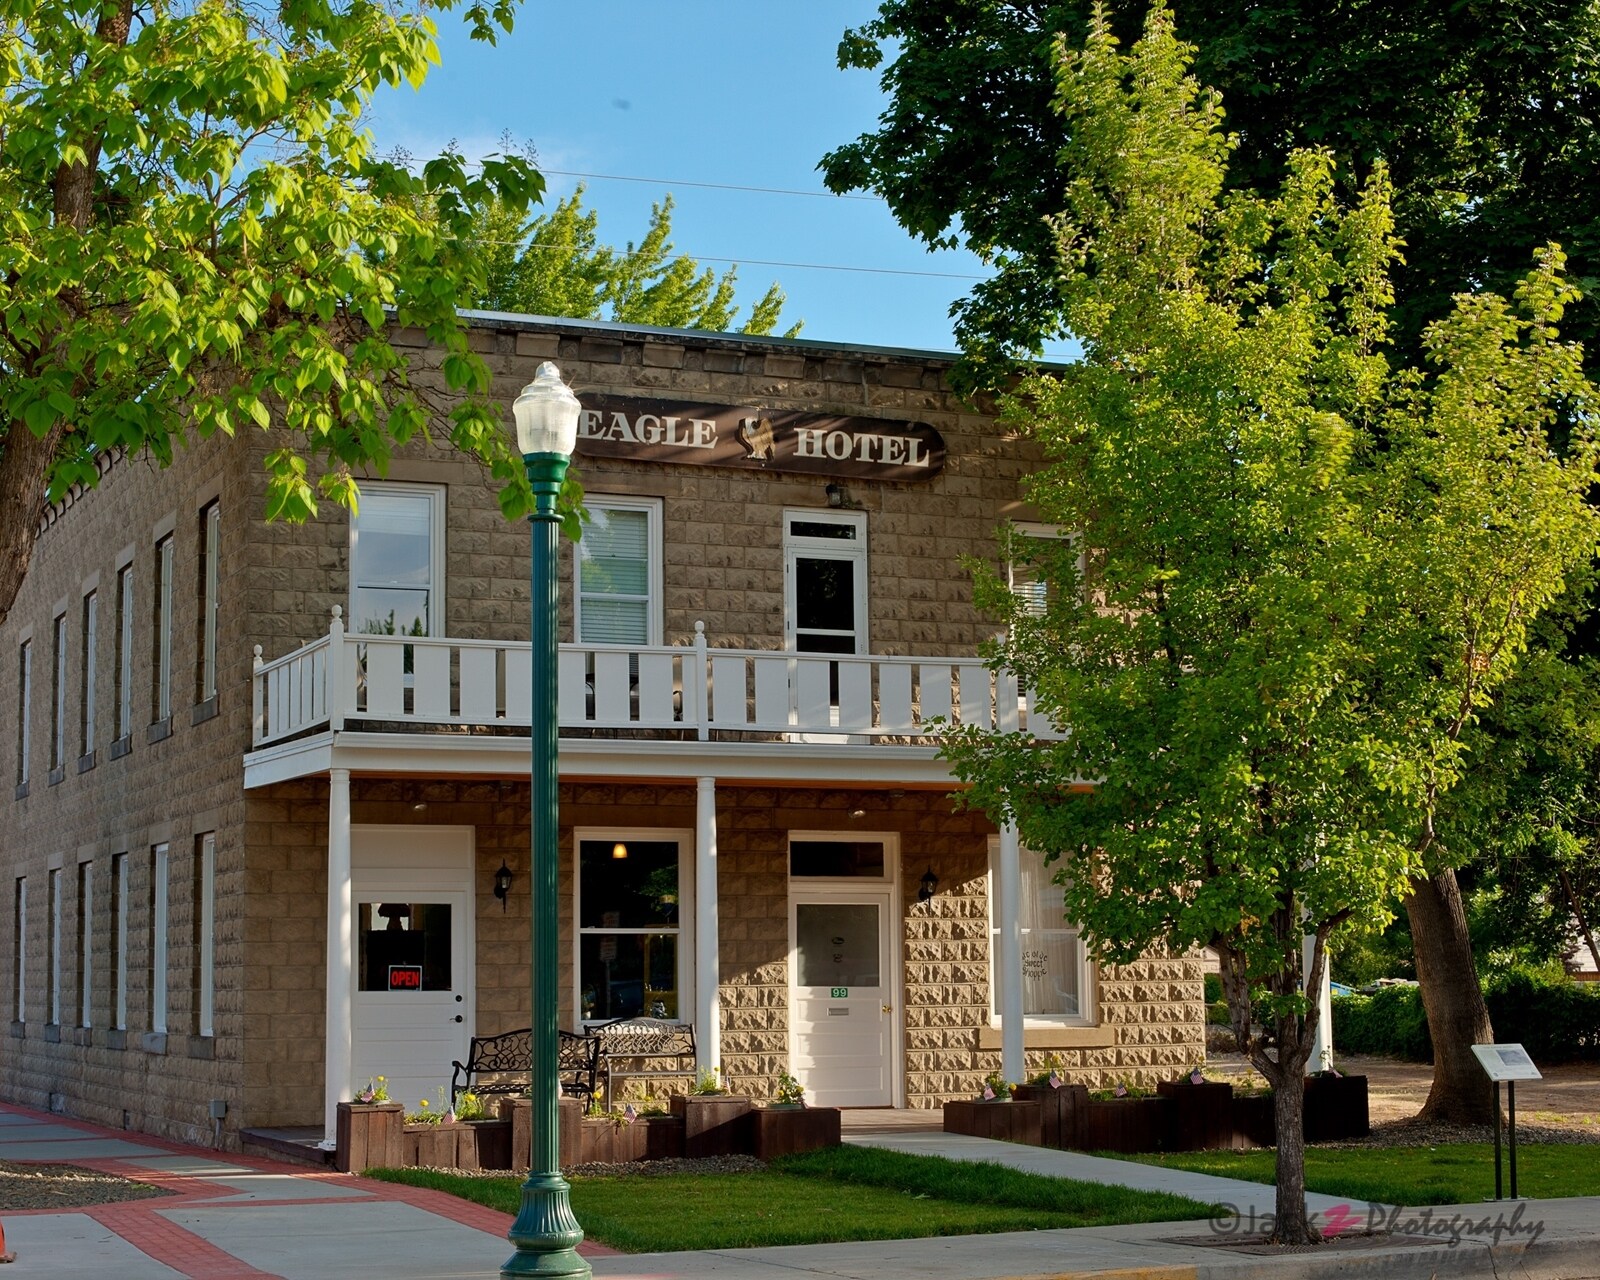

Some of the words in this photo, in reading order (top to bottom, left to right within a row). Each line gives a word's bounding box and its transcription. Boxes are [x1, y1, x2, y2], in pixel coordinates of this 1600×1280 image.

[577, 409, 719, 449] EAGLE
[793, 427, 930, 468] HOTEL
[391, 970, 419, 986] OPEN
[832, 988, 847, 997] 99
